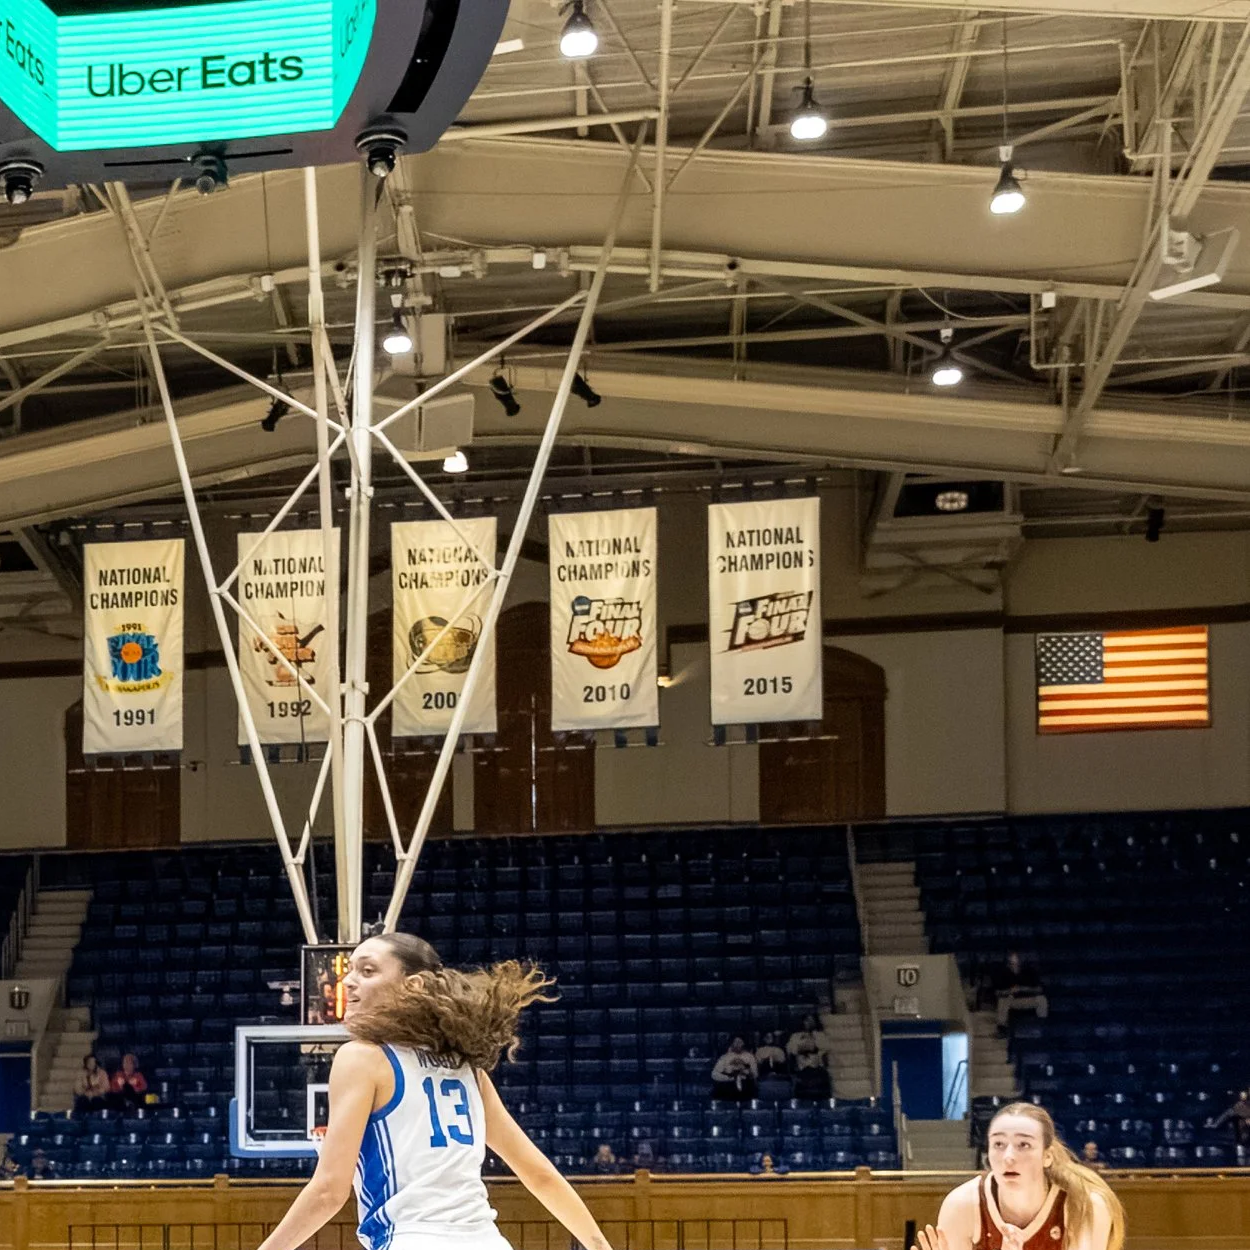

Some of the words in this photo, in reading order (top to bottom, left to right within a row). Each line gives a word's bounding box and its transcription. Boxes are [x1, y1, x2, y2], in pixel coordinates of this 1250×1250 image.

[6, 17, 44, 87] Eats
[86, 63, 190, 98] Uber
[200, 50, 304, 90] Eats
[566, 536, 641, 558] NATIONAL
[725, 526, 804, 549] NATIONAL
[253, 556, 325, 576] NATIONAL
[407, 545, 480, 566] NATIONAL
[718, 549, 814, 574] CHAMPIONS
[99, 565, 170, 586] NATIONAL
[399, 567, 489, 590] CHAMPIONS
[557, 560, 650, 582] CHAMPIONS
[90, 589, 178, 610] CHAMPIONS
[244, 580, 325, 600] CHAMPION
[589, 600, 642, 619] FINAL
[121, 622, 142, 632] 1991
[568, 617, 642, 644] FOUR
[734, 612, 810, 646] FOUR
[583, 683, 631, 702] 2010
[743, 676, 793, 696] 2015
[267, 700, 312, 718] 1992
[422, 691, 461, 710] 200
[113, 709, 156, 726] 1991
[900, 969, 917, 985] 10
[422, 1076, 474, 1147] 13
